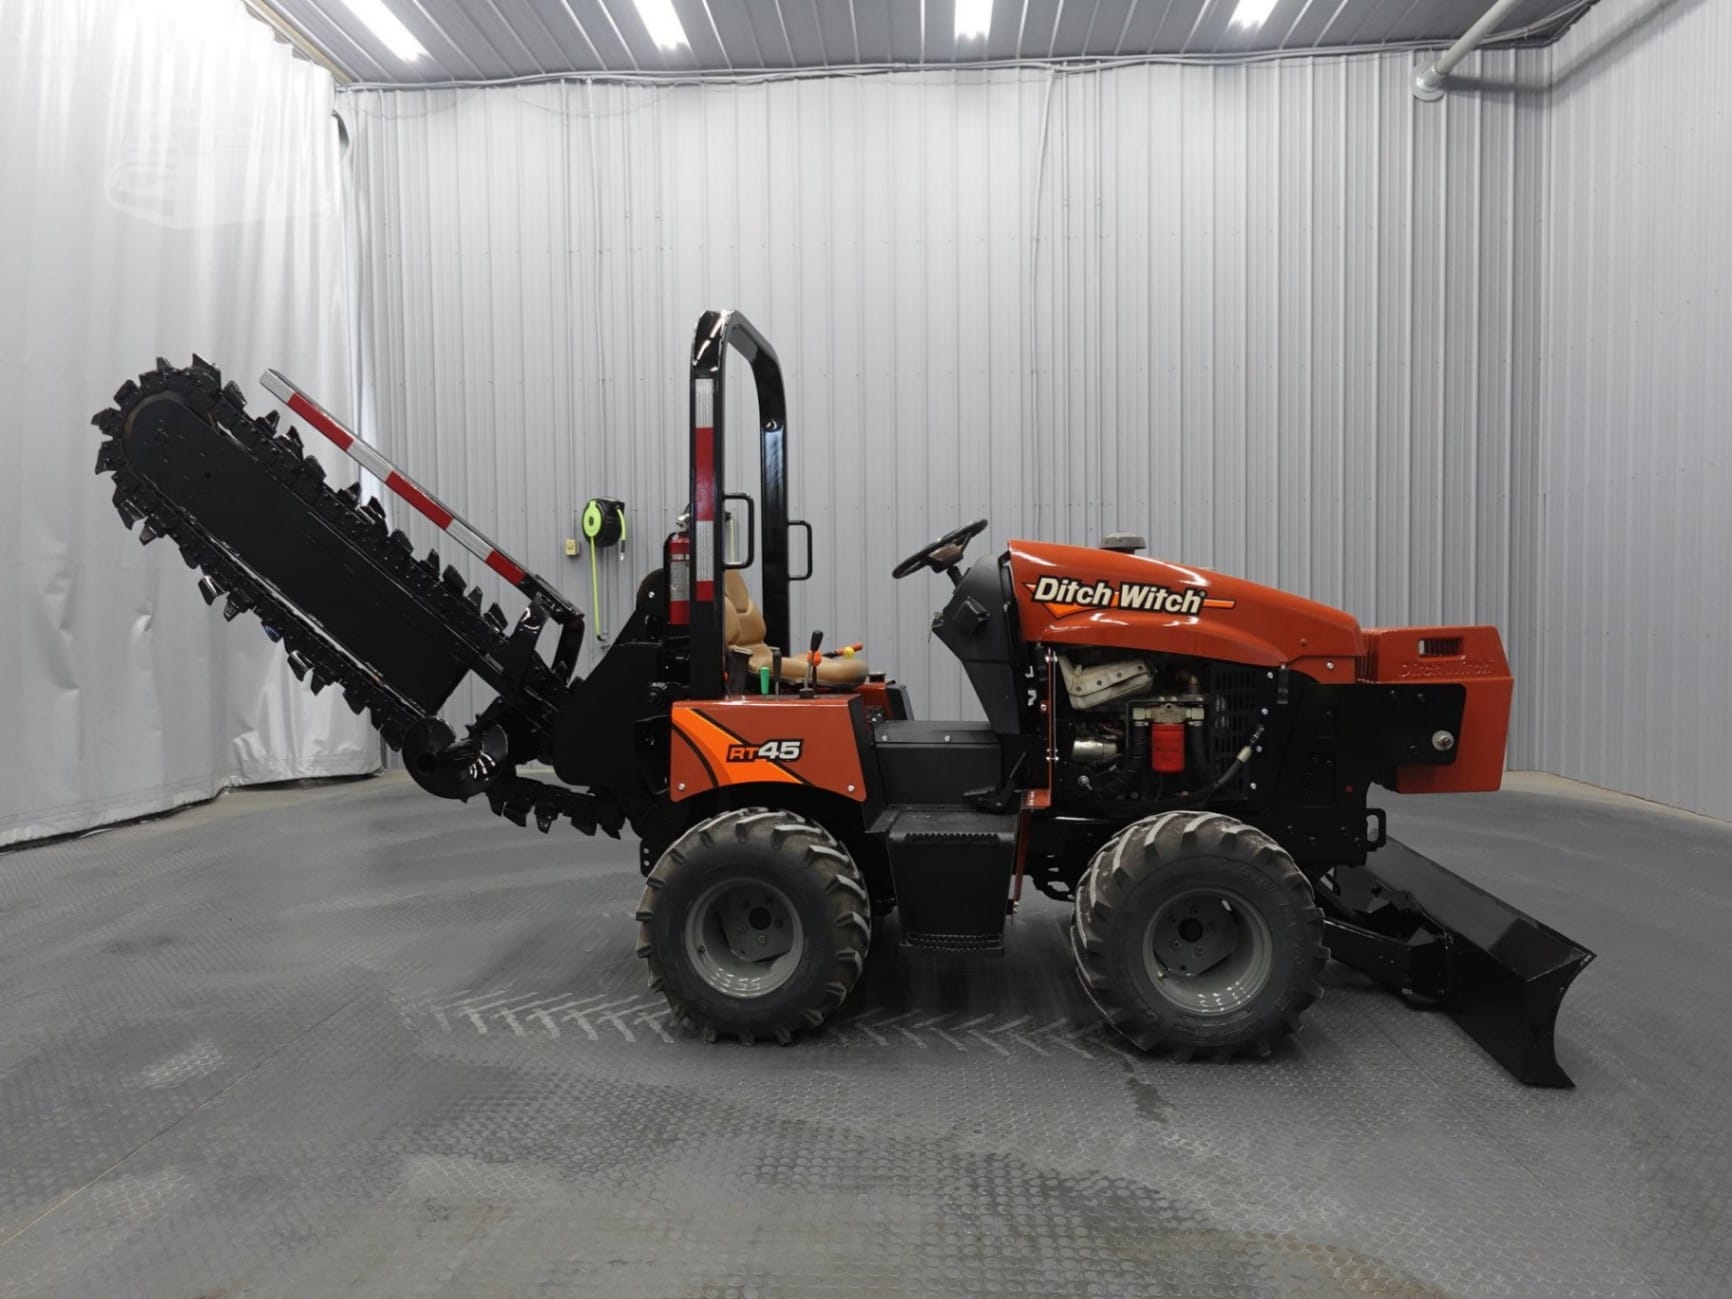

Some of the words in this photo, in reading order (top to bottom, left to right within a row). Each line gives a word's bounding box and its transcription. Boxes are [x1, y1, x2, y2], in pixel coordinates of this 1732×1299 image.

[1034, 576, 1113, 606] Ditch
[1120, 583, 1201, 614] Witch
[729, 741, 801, 760] RT45
